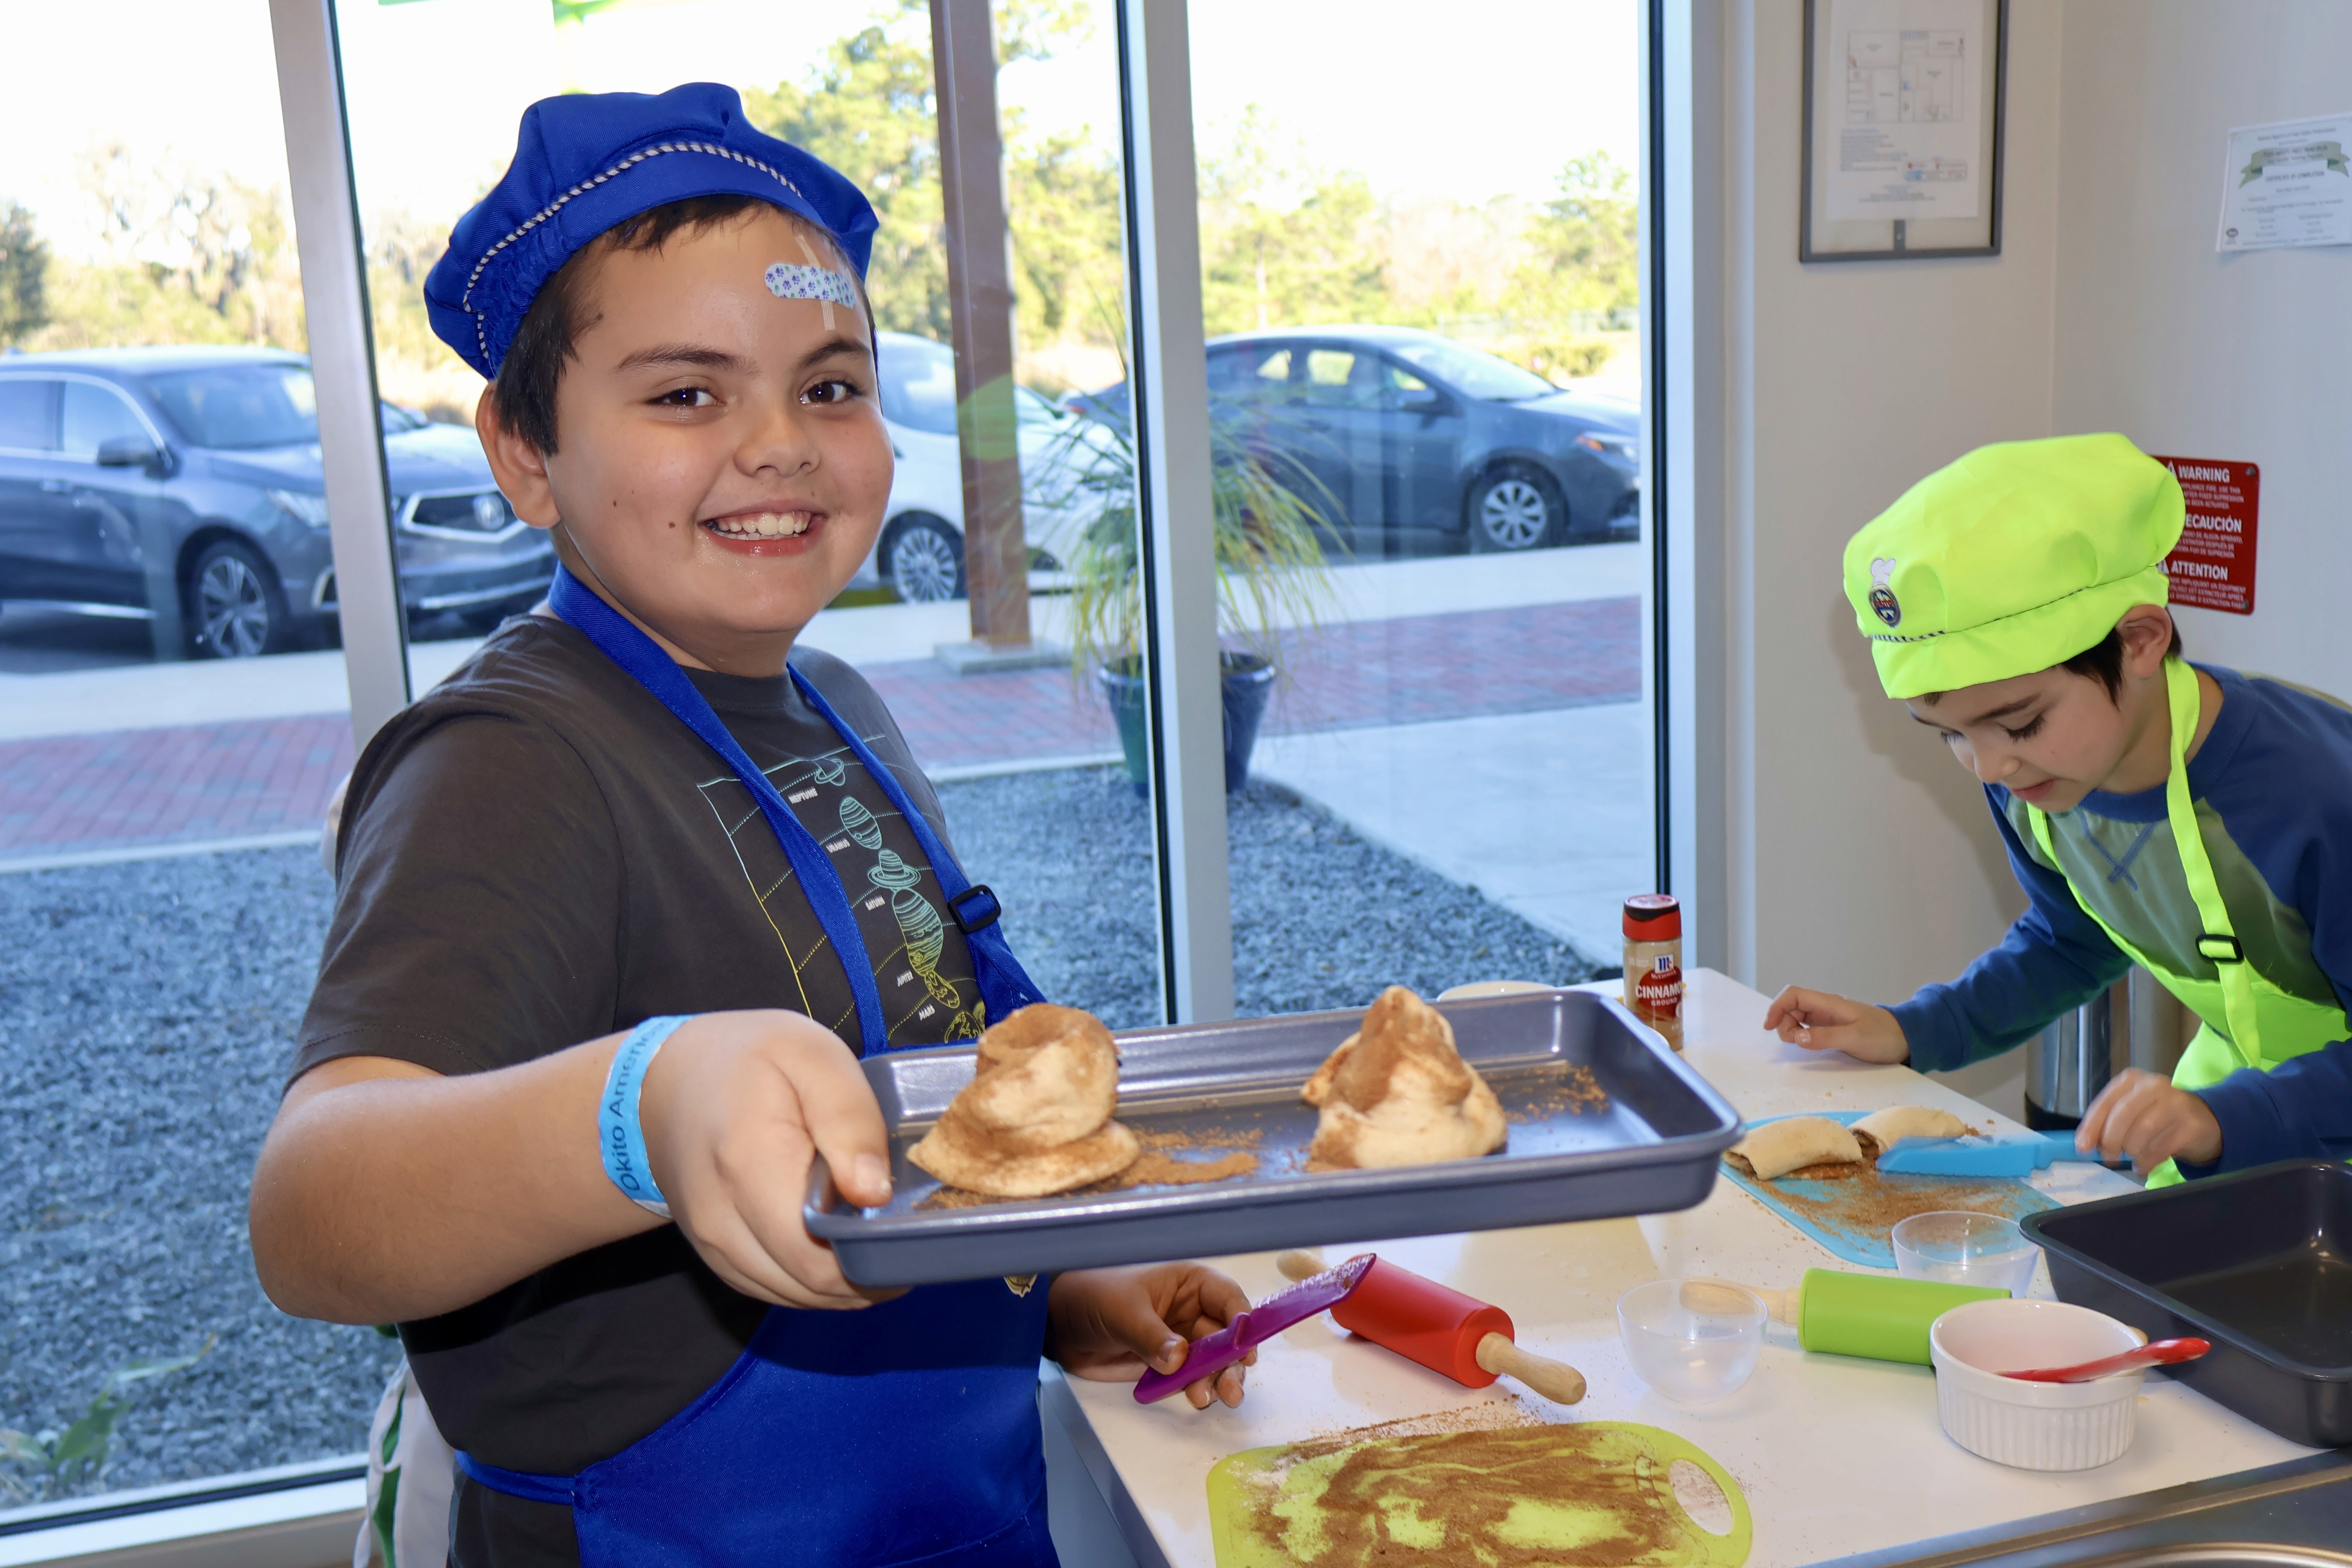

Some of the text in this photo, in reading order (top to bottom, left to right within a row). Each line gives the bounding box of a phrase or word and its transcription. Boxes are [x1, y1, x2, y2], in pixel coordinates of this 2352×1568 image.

[2178, 465, 2230, 483] WARNING
[2185, 513, 2242, 533] ECAUCIÓN
[2171, 560, 2228, 581] ATTENTION
[788, 787, 818, 804] NEPTUNE
[826, 838, 851, 853] URANUS
[864, 895, 886, 911] SATURN
[897, 970, 914, 987] JUPITER
[1635, 981, 1682, 999] CINNAMO
[1651, 998, 1678, 1006] GROUND
[918, 1004, 935, 1021] MARS
[610, 1127, 639, 1191] Okito
